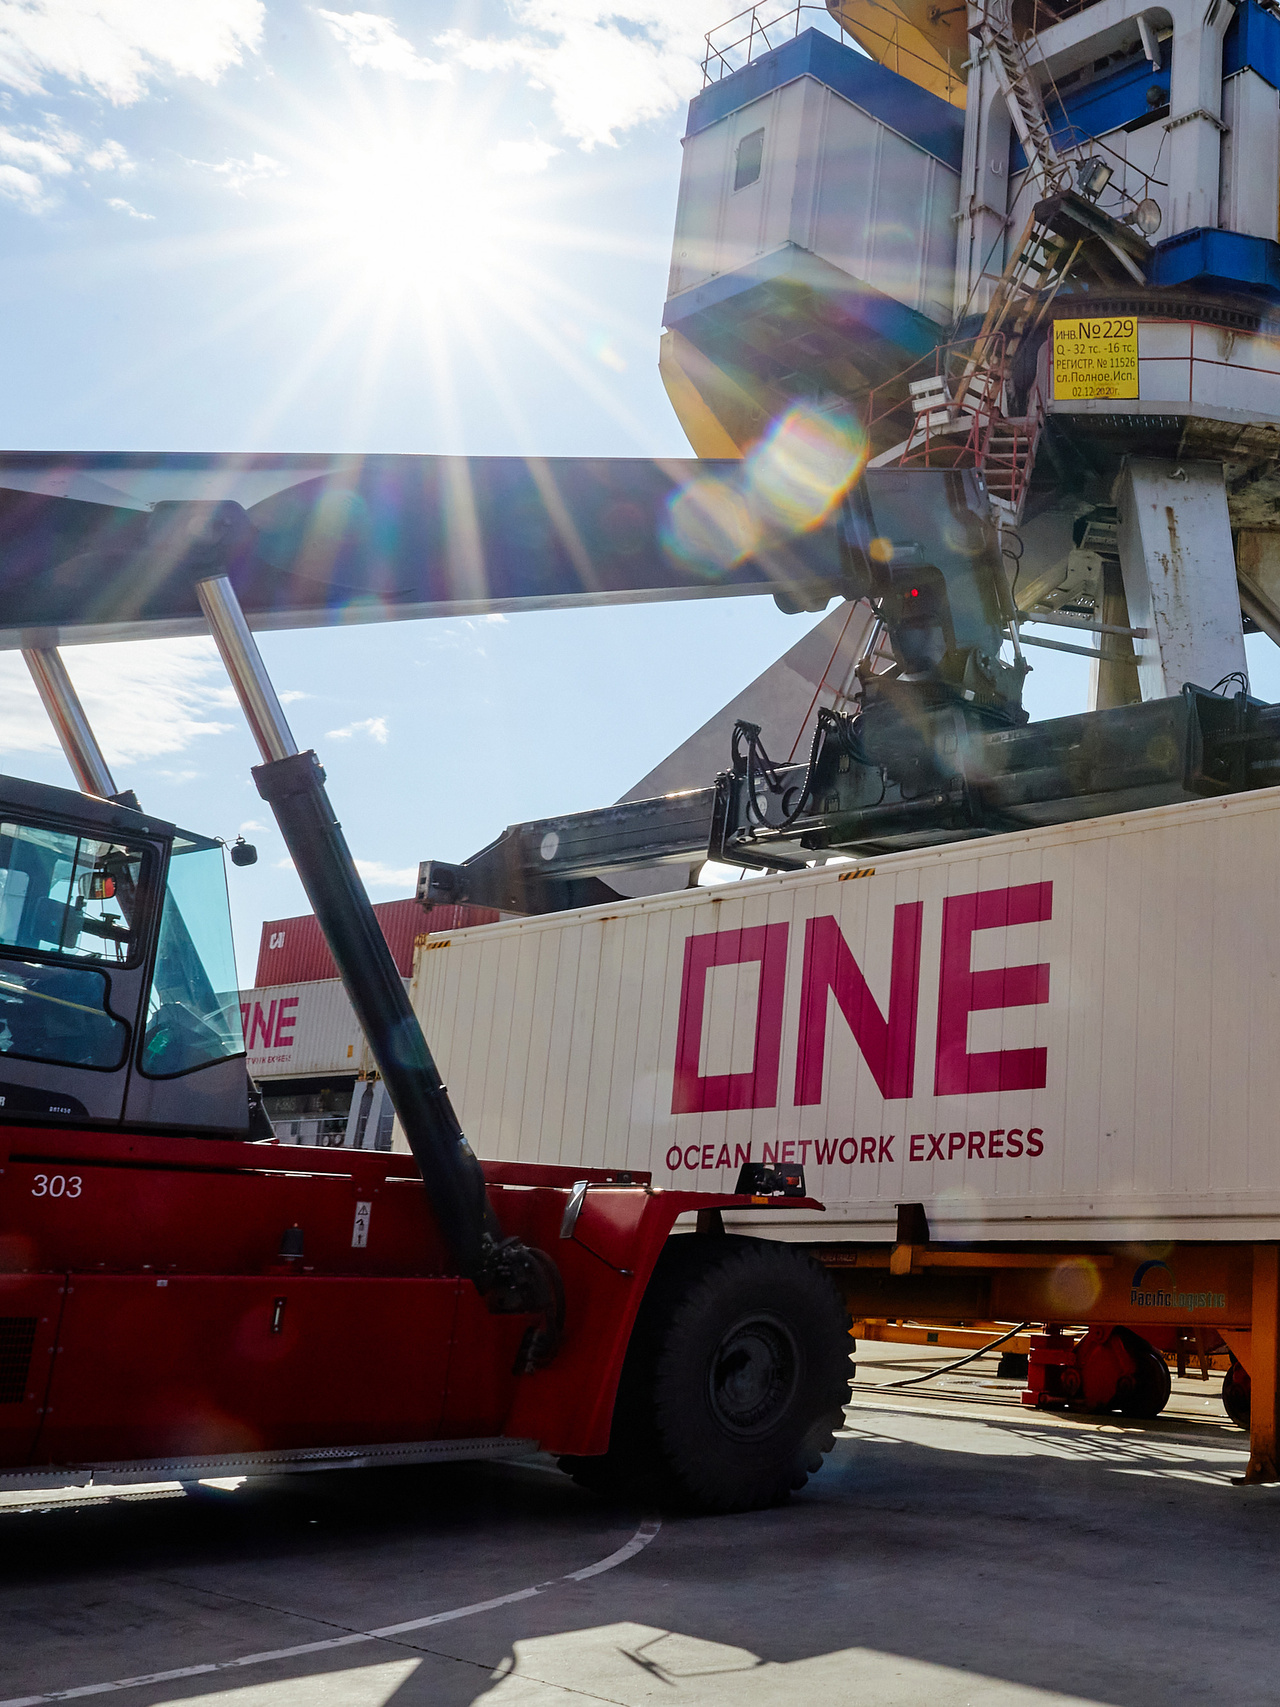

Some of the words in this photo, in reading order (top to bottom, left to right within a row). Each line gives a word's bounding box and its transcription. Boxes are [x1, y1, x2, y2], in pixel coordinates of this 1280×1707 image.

[1057, 344, 1065, 356] Q
[1074, 344, 1086, 354] 32
[1056, 359, 1094, 369] РЕГИСТР.
[1110, 357, 1136, 368] 11526
[671, 880, 1053, 1115] ONE
[666, 1141, 751, 1171] OCEAN
[761, 1135, 895, 1166] NETWORK
[909, 1128, 1044, 1163] EXPRESS
[31, 1174, 82, 1198] 303
